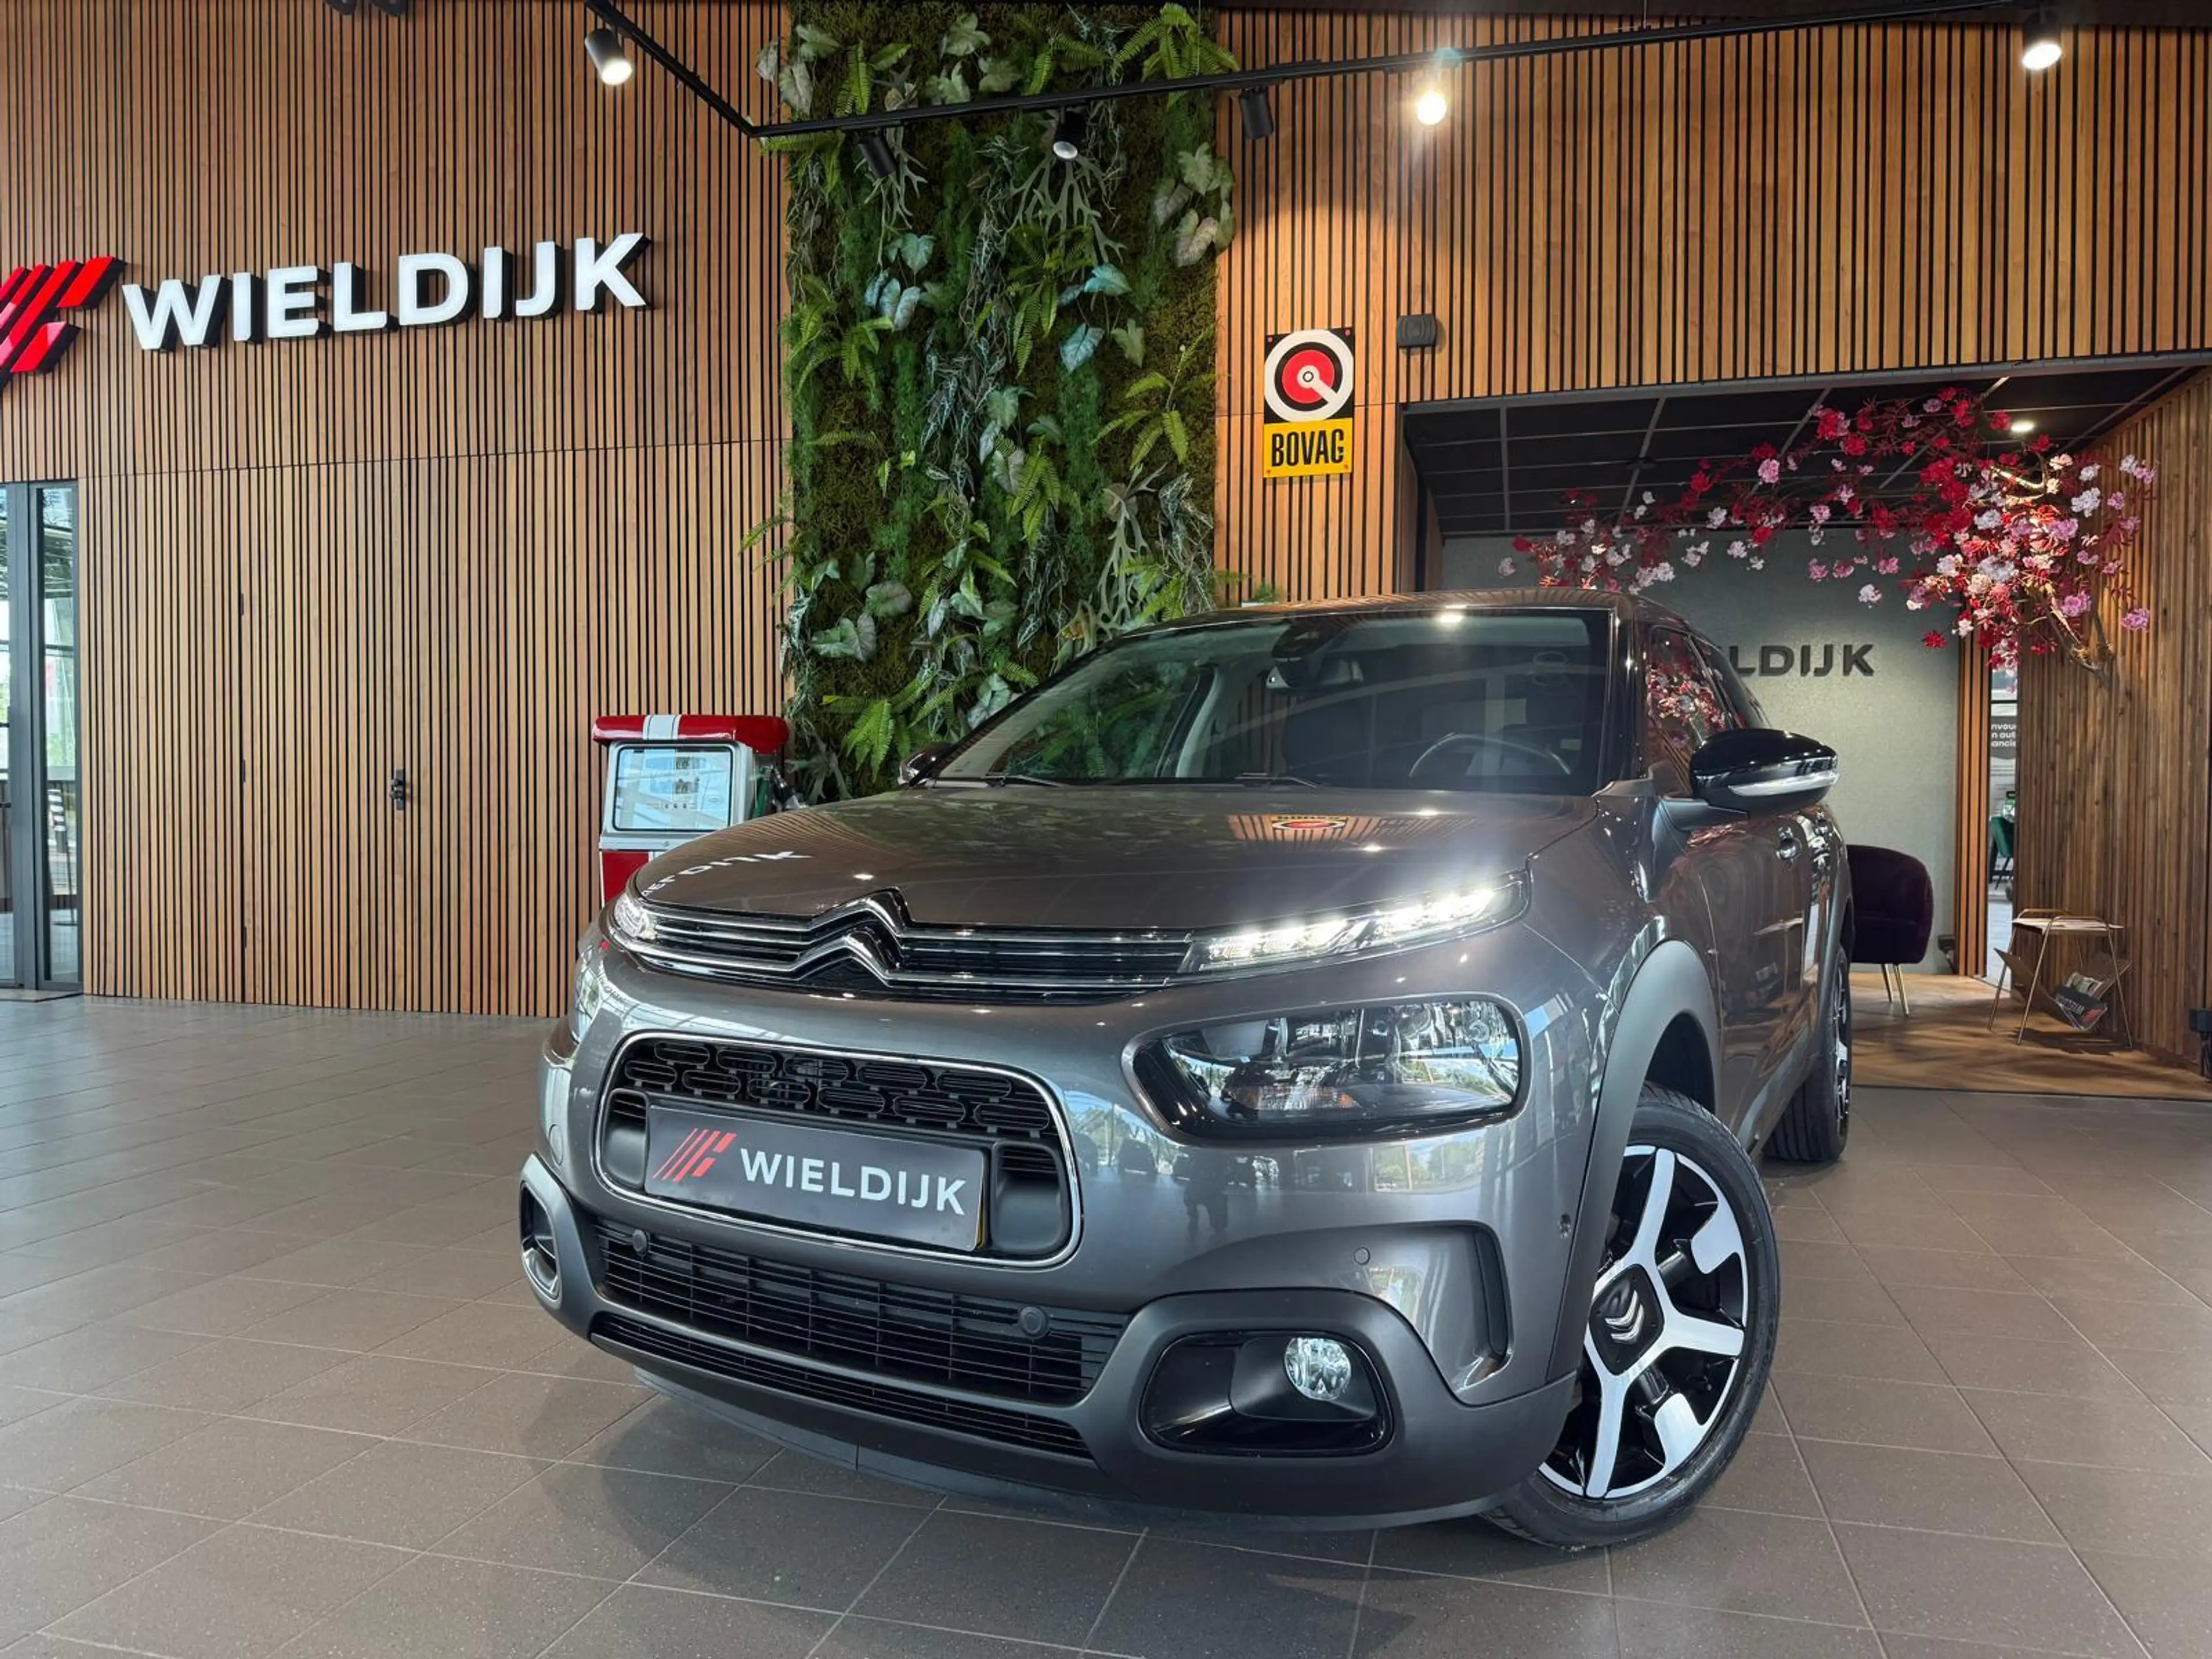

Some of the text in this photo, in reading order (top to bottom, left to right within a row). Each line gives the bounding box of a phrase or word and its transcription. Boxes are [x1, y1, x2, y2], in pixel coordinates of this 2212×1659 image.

[122, 232, 648, 350] WIELDIJK
[1271, 428, 1344, 467] BOVAG
[1716, 643, 1874, 676] LDIJK
[740, 1148, 966, 1215] WIELDIJK
